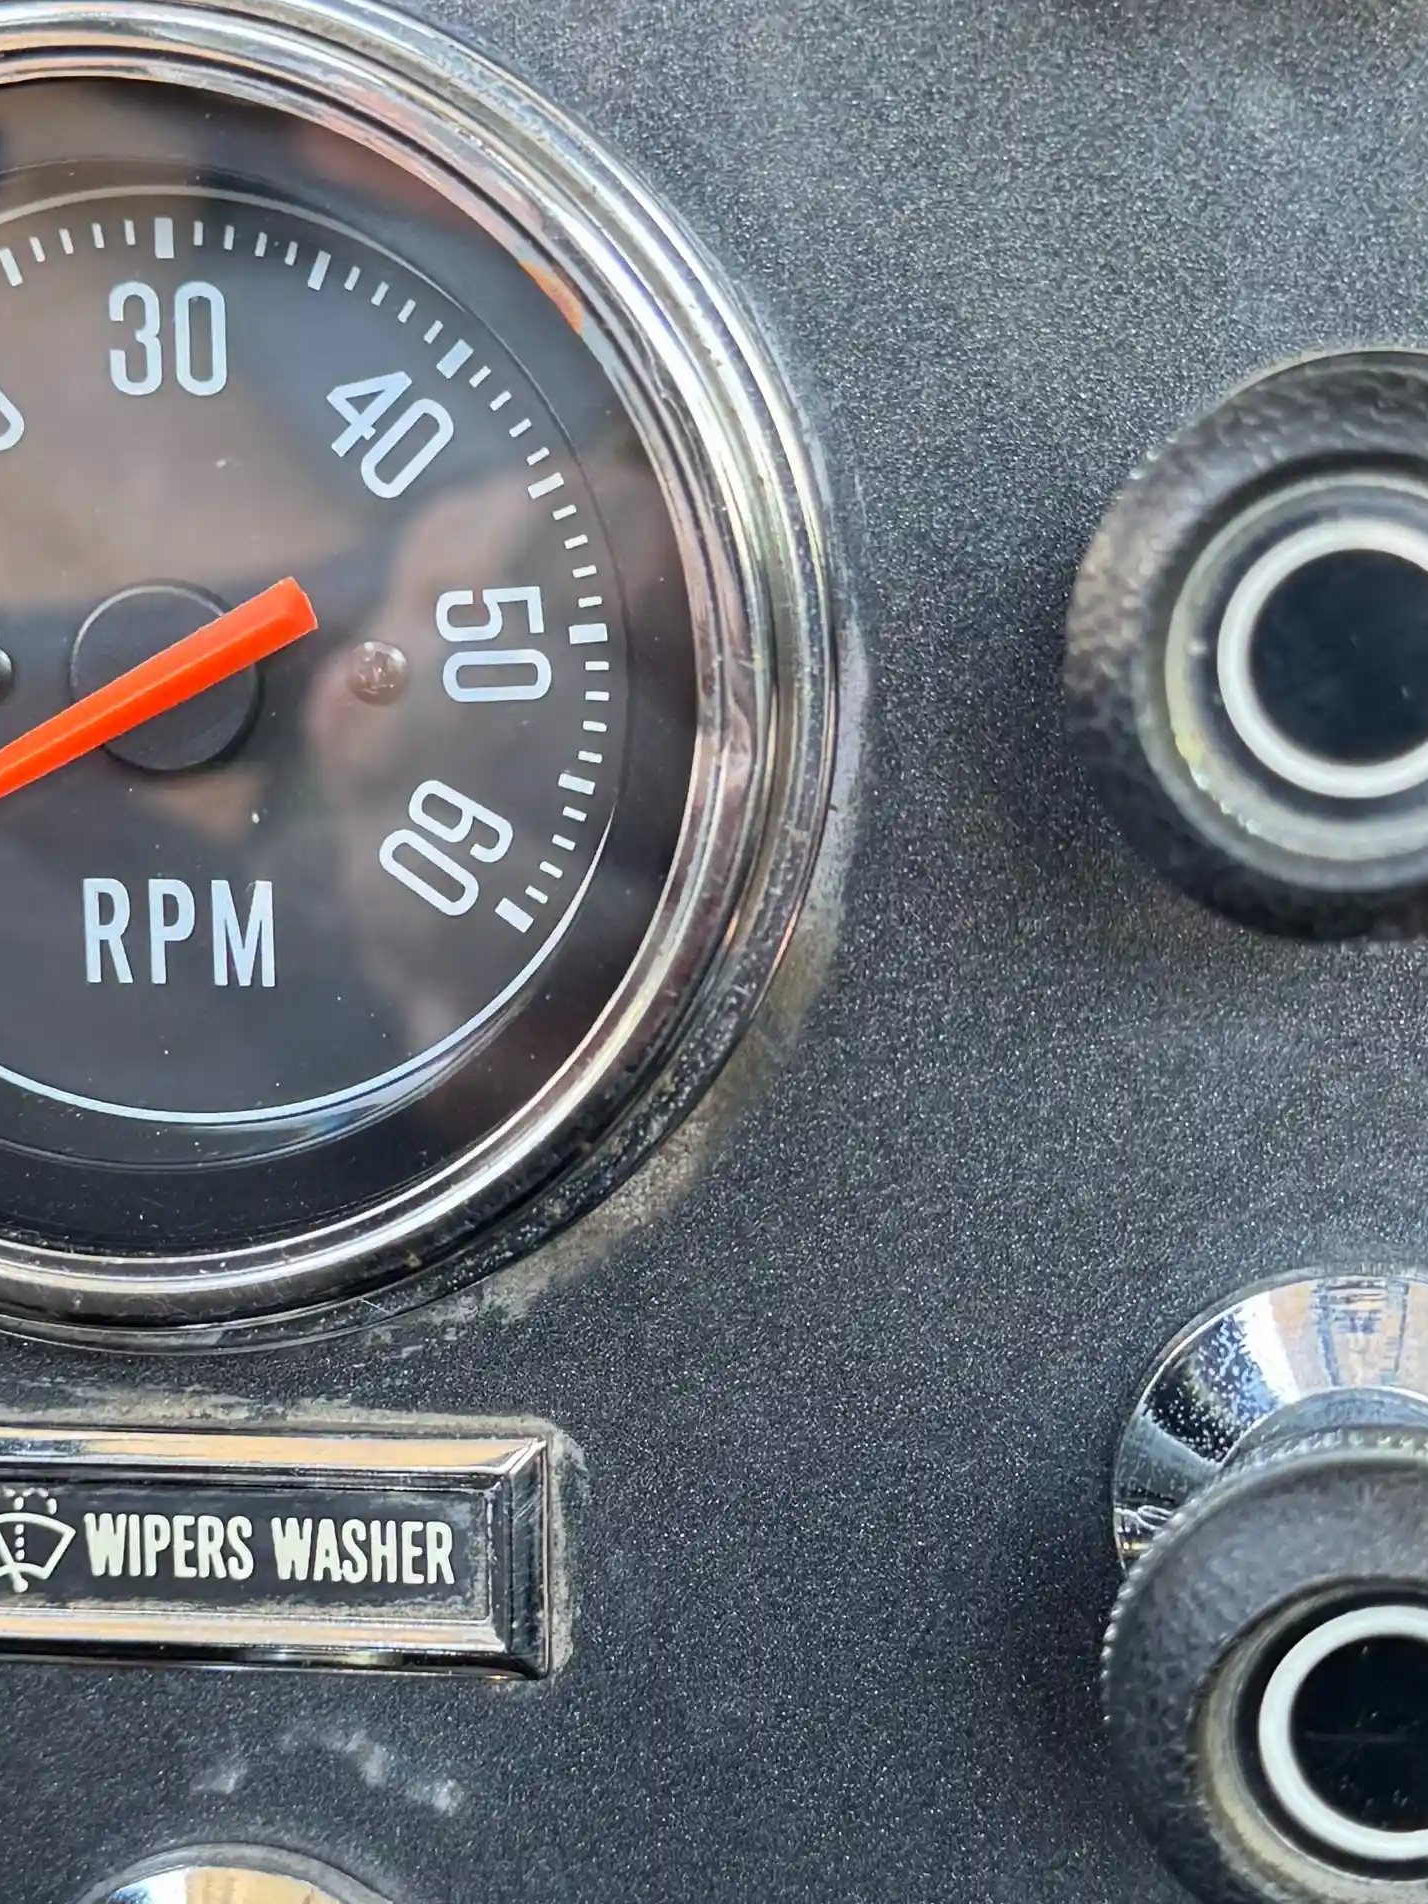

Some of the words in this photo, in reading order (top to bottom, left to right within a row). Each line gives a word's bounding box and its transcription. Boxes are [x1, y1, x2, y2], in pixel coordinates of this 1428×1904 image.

[108, 281, 228, 396] 30
[326, 369, 454, 498] 40
[434, 585, 552, 703] 50
[378, 779, 513, 918] 60
[82, 877, 277, 987] RPM
[83, 1512, 254, 1580] WIPERS
[272, 1517, 456, 1585] WASHER
